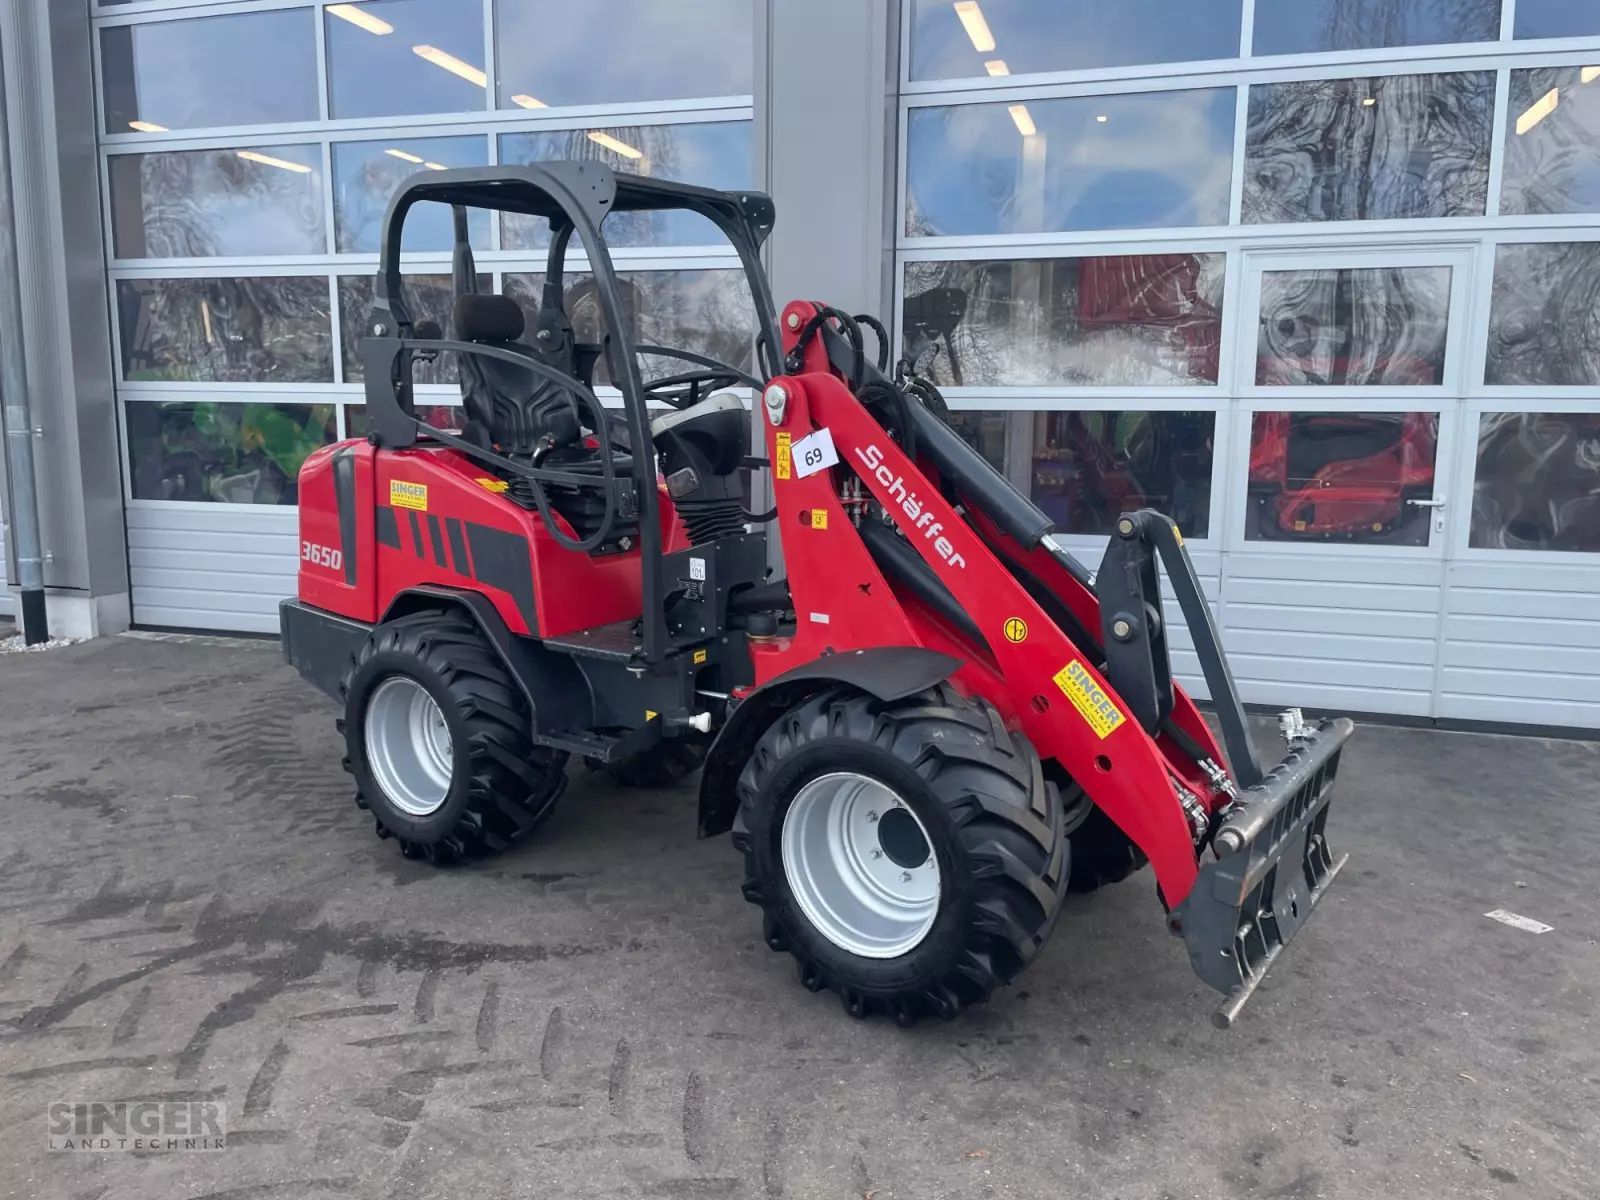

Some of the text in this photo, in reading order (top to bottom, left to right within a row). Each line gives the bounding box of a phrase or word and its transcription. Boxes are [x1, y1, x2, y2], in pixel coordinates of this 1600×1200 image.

[804, 448, 823, 466] 69
[391, 482, 426, 498] SINGER
[854, 444, 966, 569] Schäffer
[301, 540, 342, 570] 3650
[1062, 670, 1112, 729] LANDTECHNIK
[1068, 663, 1120, 724] SINGER
